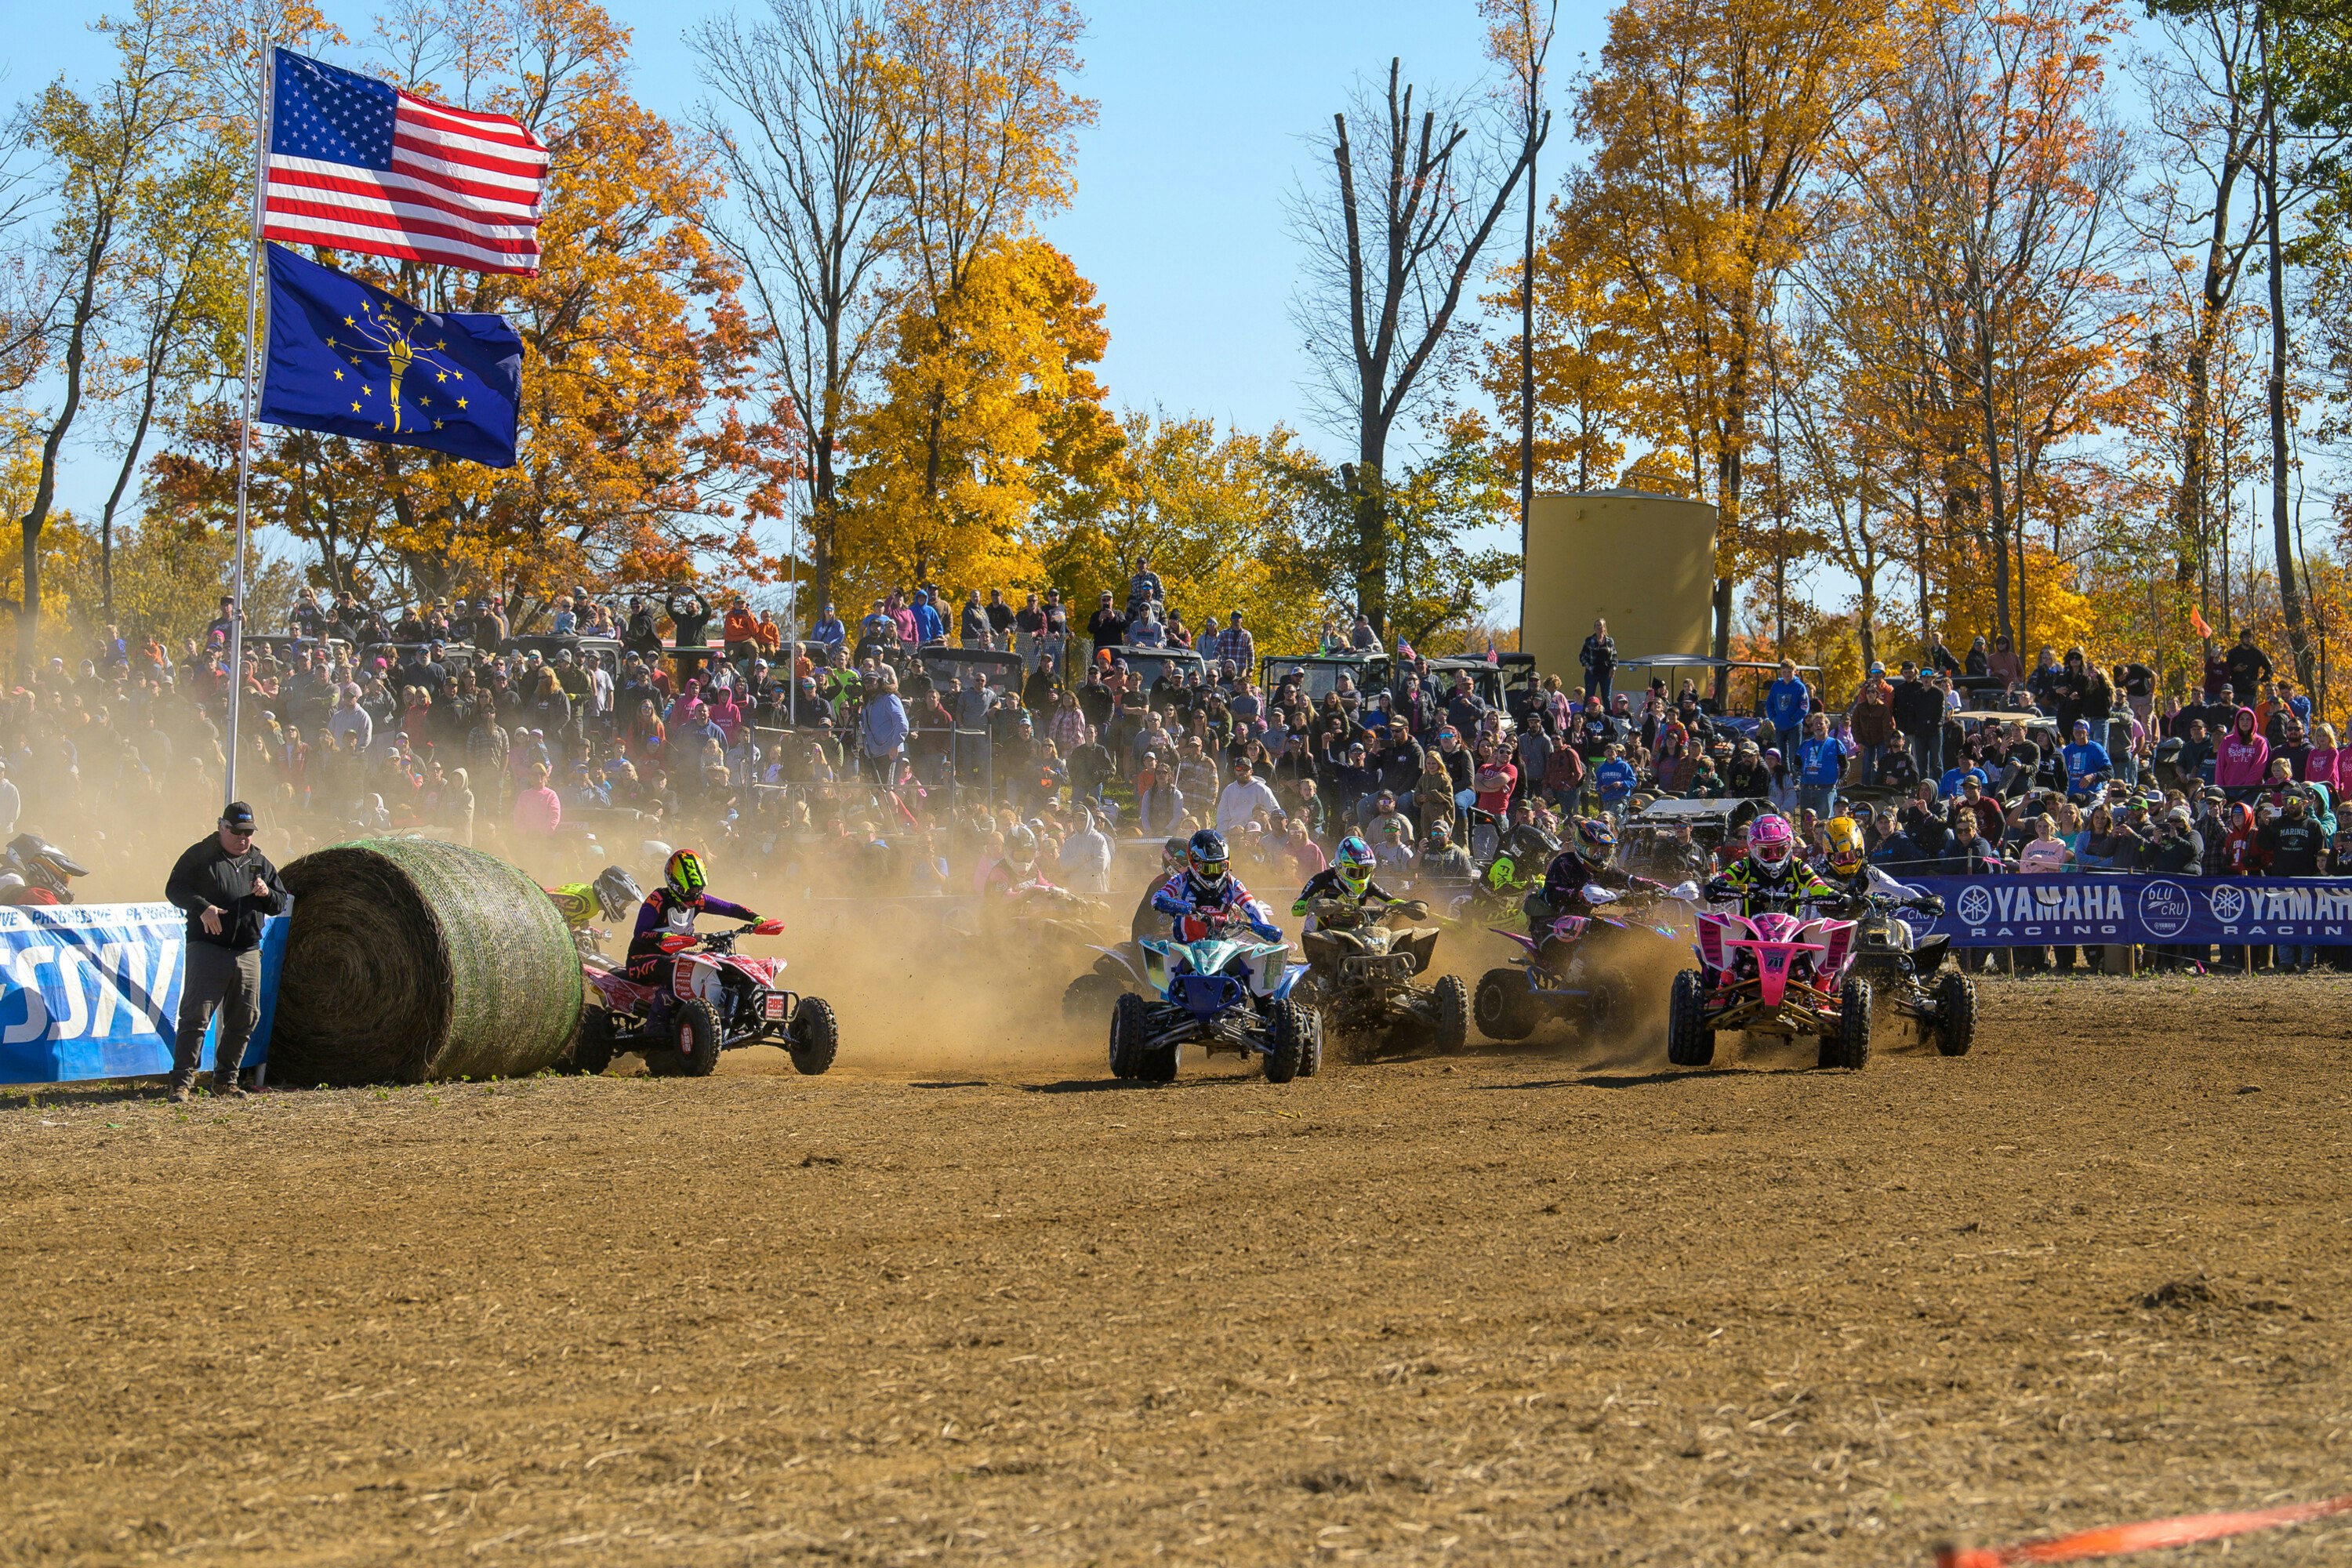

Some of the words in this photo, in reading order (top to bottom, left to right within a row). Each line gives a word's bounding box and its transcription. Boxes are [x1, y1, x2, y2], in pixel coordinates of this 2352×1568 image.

[378, 314, 401, 326] INDIANA
[2280, 828, 2309, 838] MARINES
[684, 858, 702, 886] FXR
[1994, 886, 2125, 921] YAMAHA
[1971, 925, 2117, 937] RACING
[629, 960, 658, 978] FXR
[0, 939, 186, 1044] SSIV
[768, 998, 782, 1010] 285
